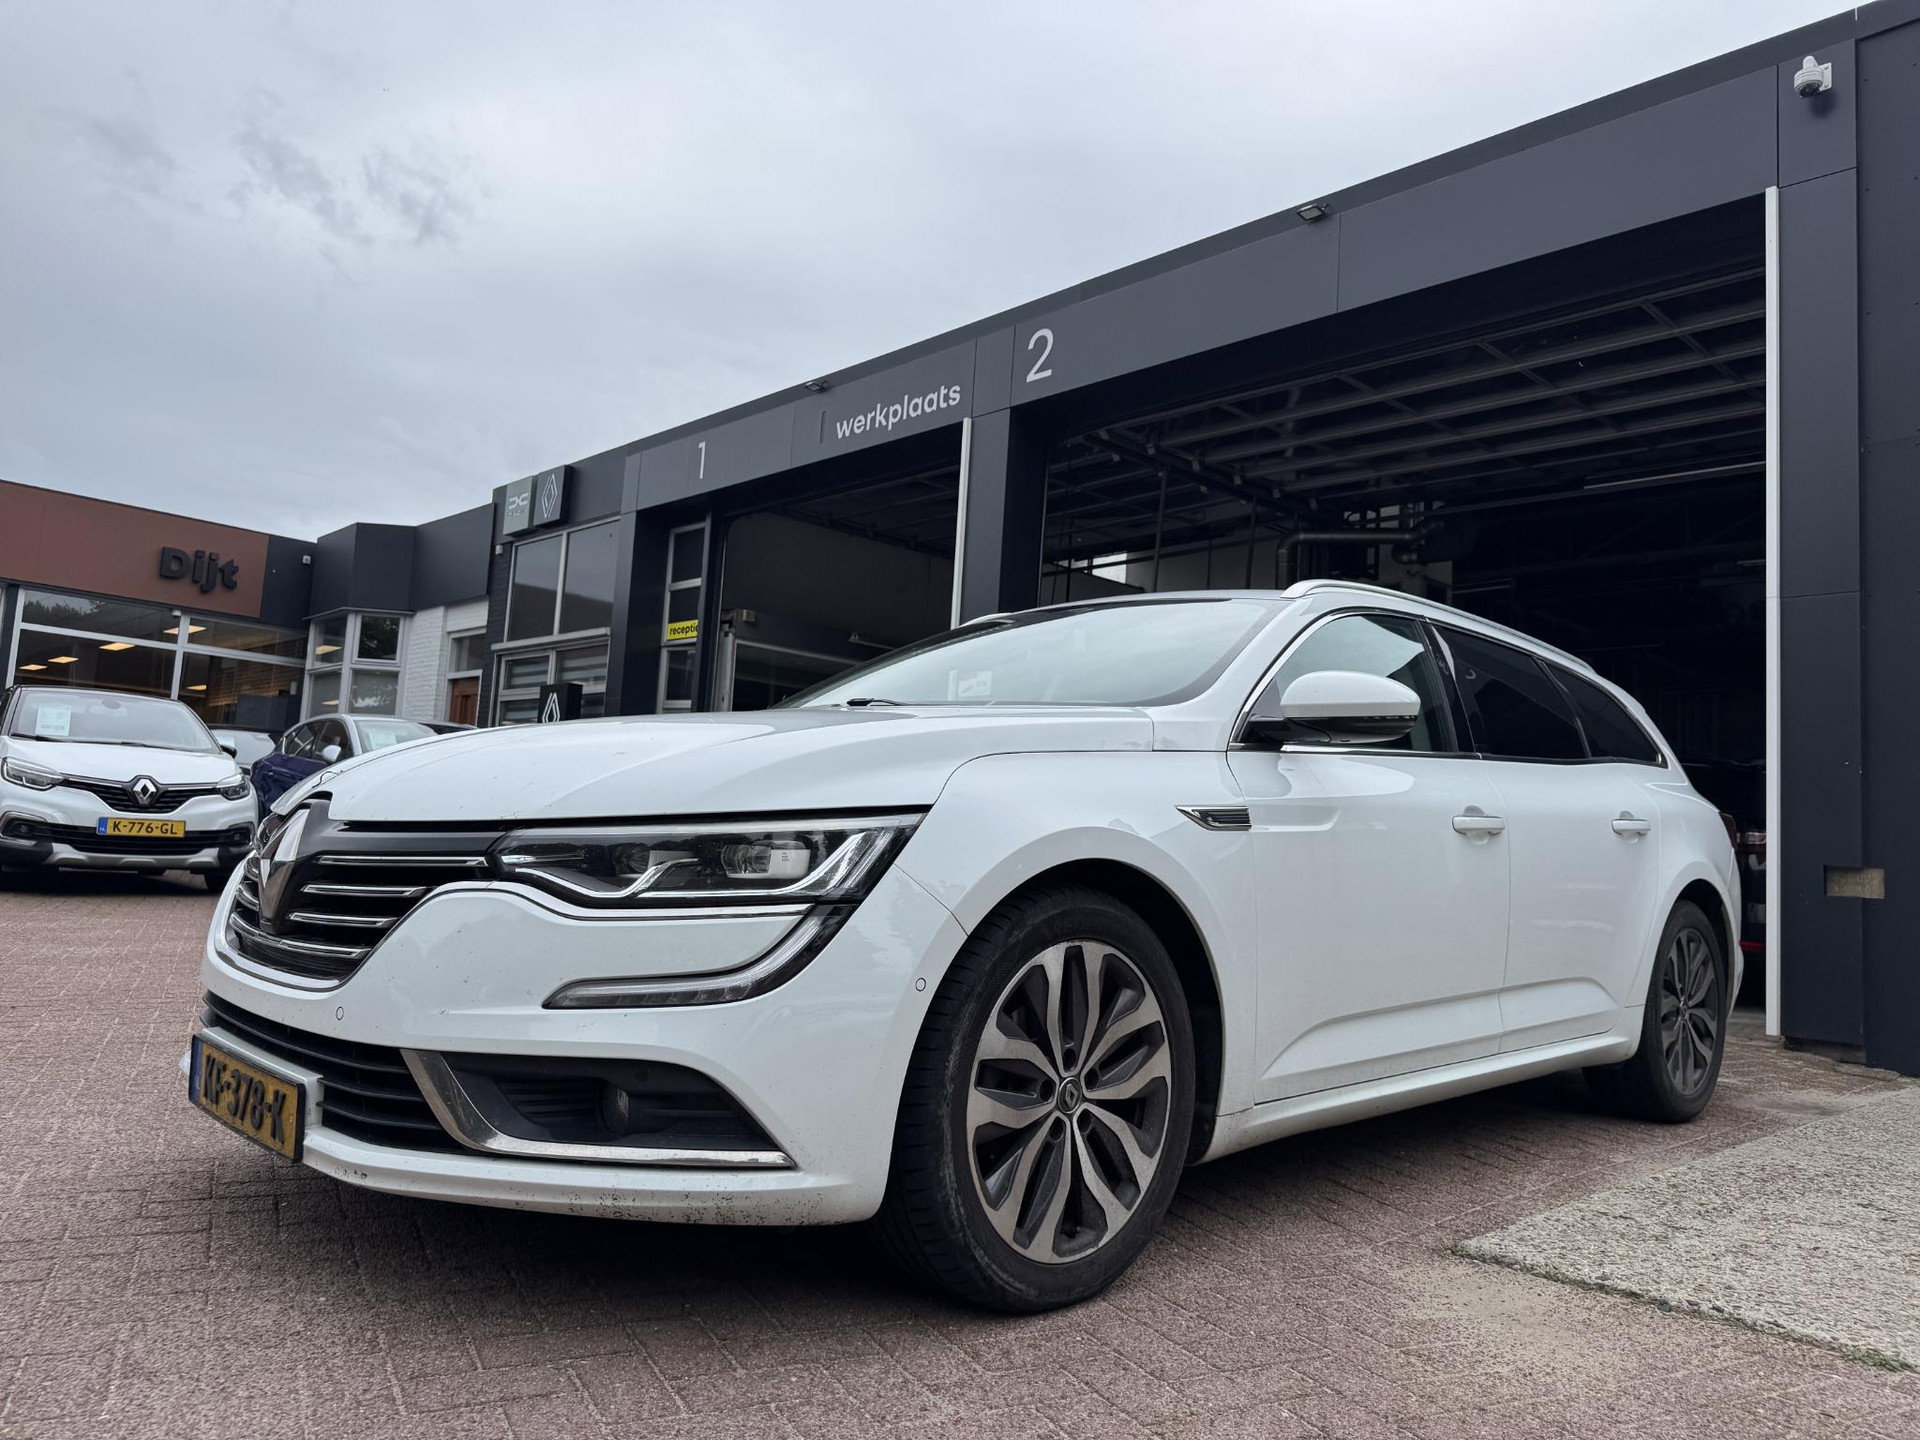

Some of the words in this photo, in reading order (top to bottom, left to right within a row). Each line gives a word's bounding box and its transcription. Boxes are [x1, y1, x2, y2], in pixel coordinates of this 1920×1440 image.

[1027, 328, 1054, 383] 2
[836, 385, 961, 439] werkplaats
[698, 441, 706, 480] 1
[160, 546, 239, 593] Dijt
[113, 820, 178, 835] K-776-GL
